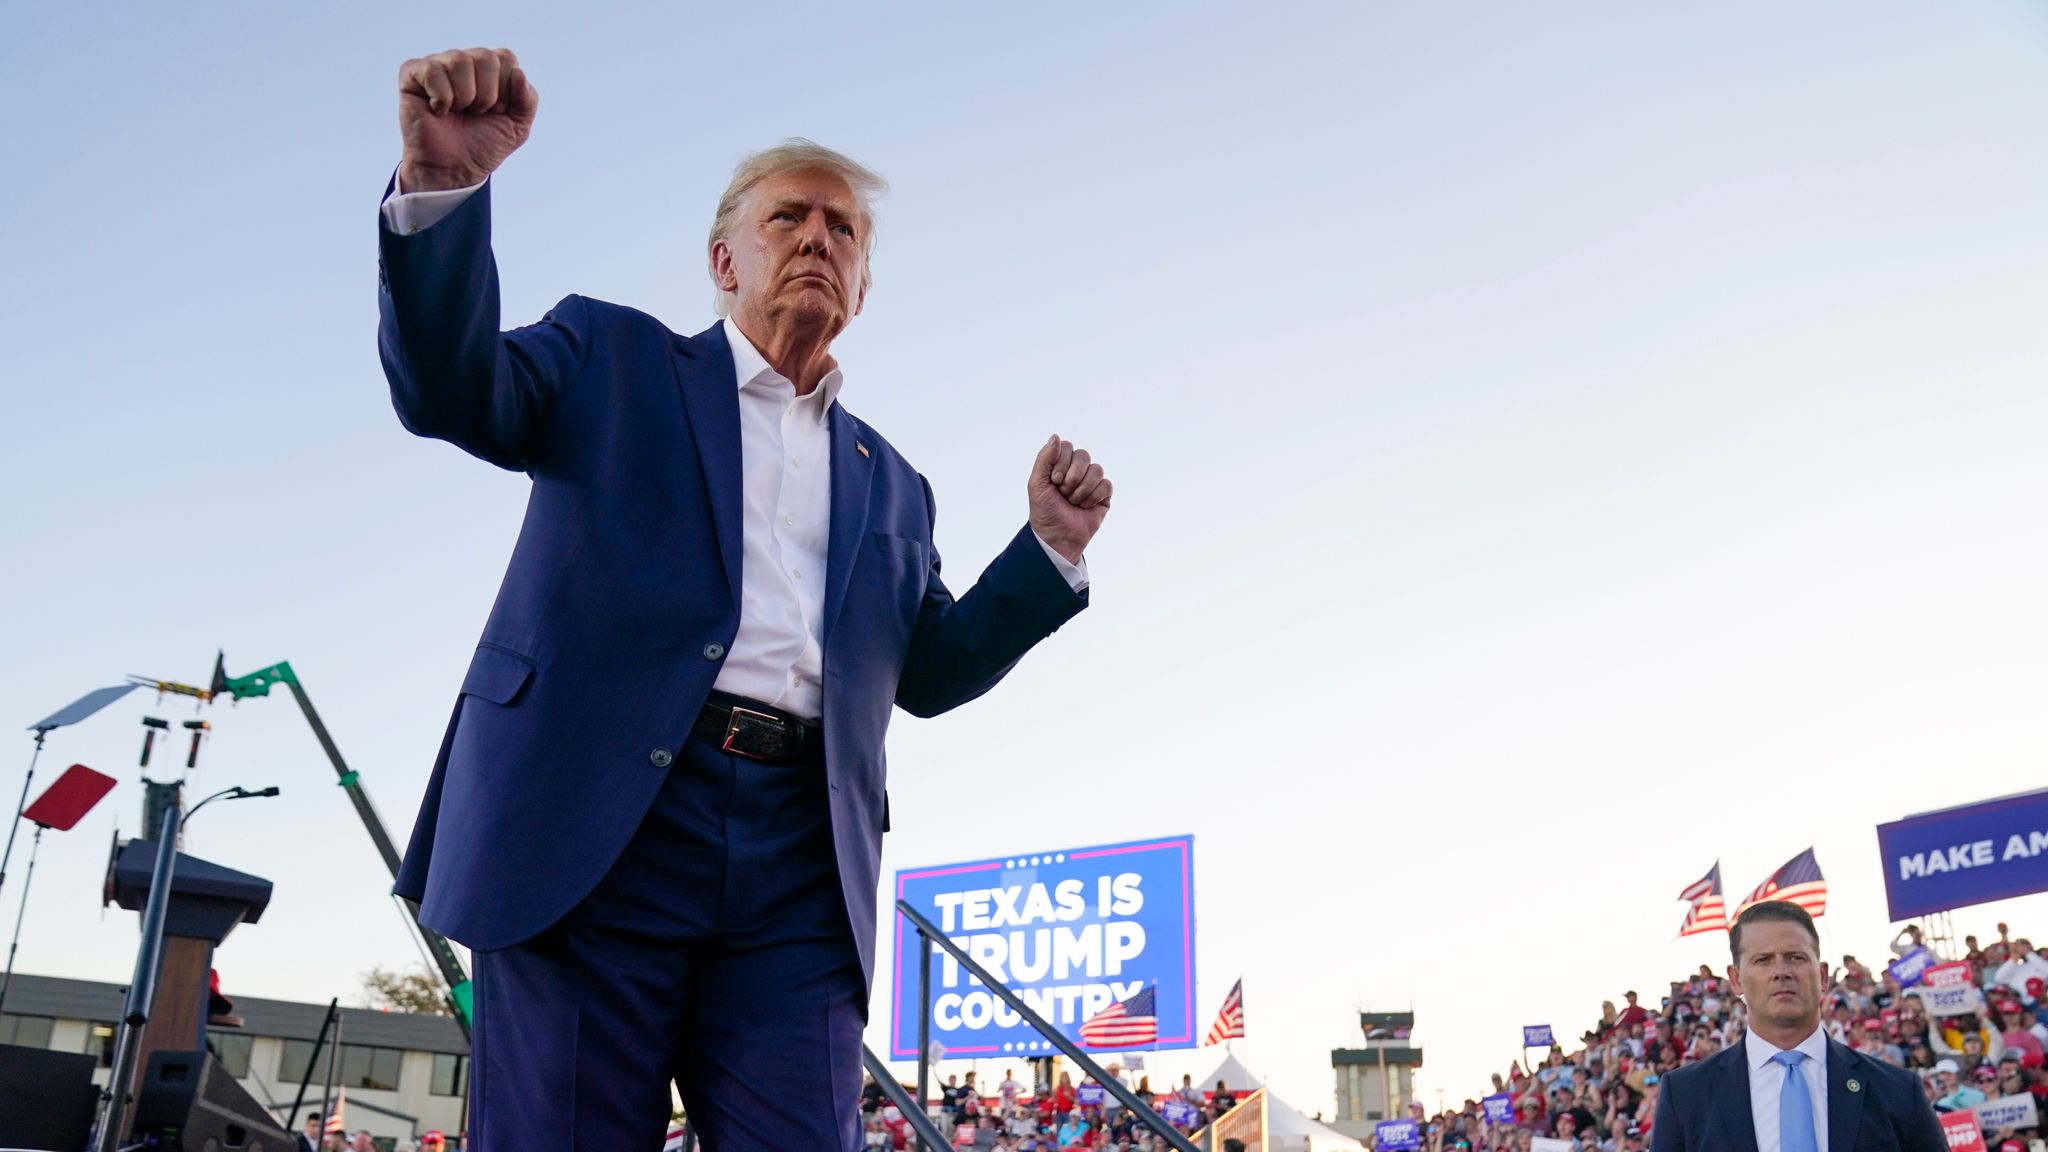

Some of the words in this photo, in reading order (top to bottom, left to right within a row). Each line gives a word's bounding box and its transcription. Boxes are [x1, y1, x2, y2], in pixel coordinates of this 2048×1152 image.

[1899, 840, 1994, 881] MAKE
[934, 879, 1085, 932] TEXAS
[1098, 873, 1144, 917] IS
[932, 920, 1146, 988] TRUMP
[1980, 1104, 2028, 1118] WITCH
[1985, 1113, 2023, 1125] HUNT
